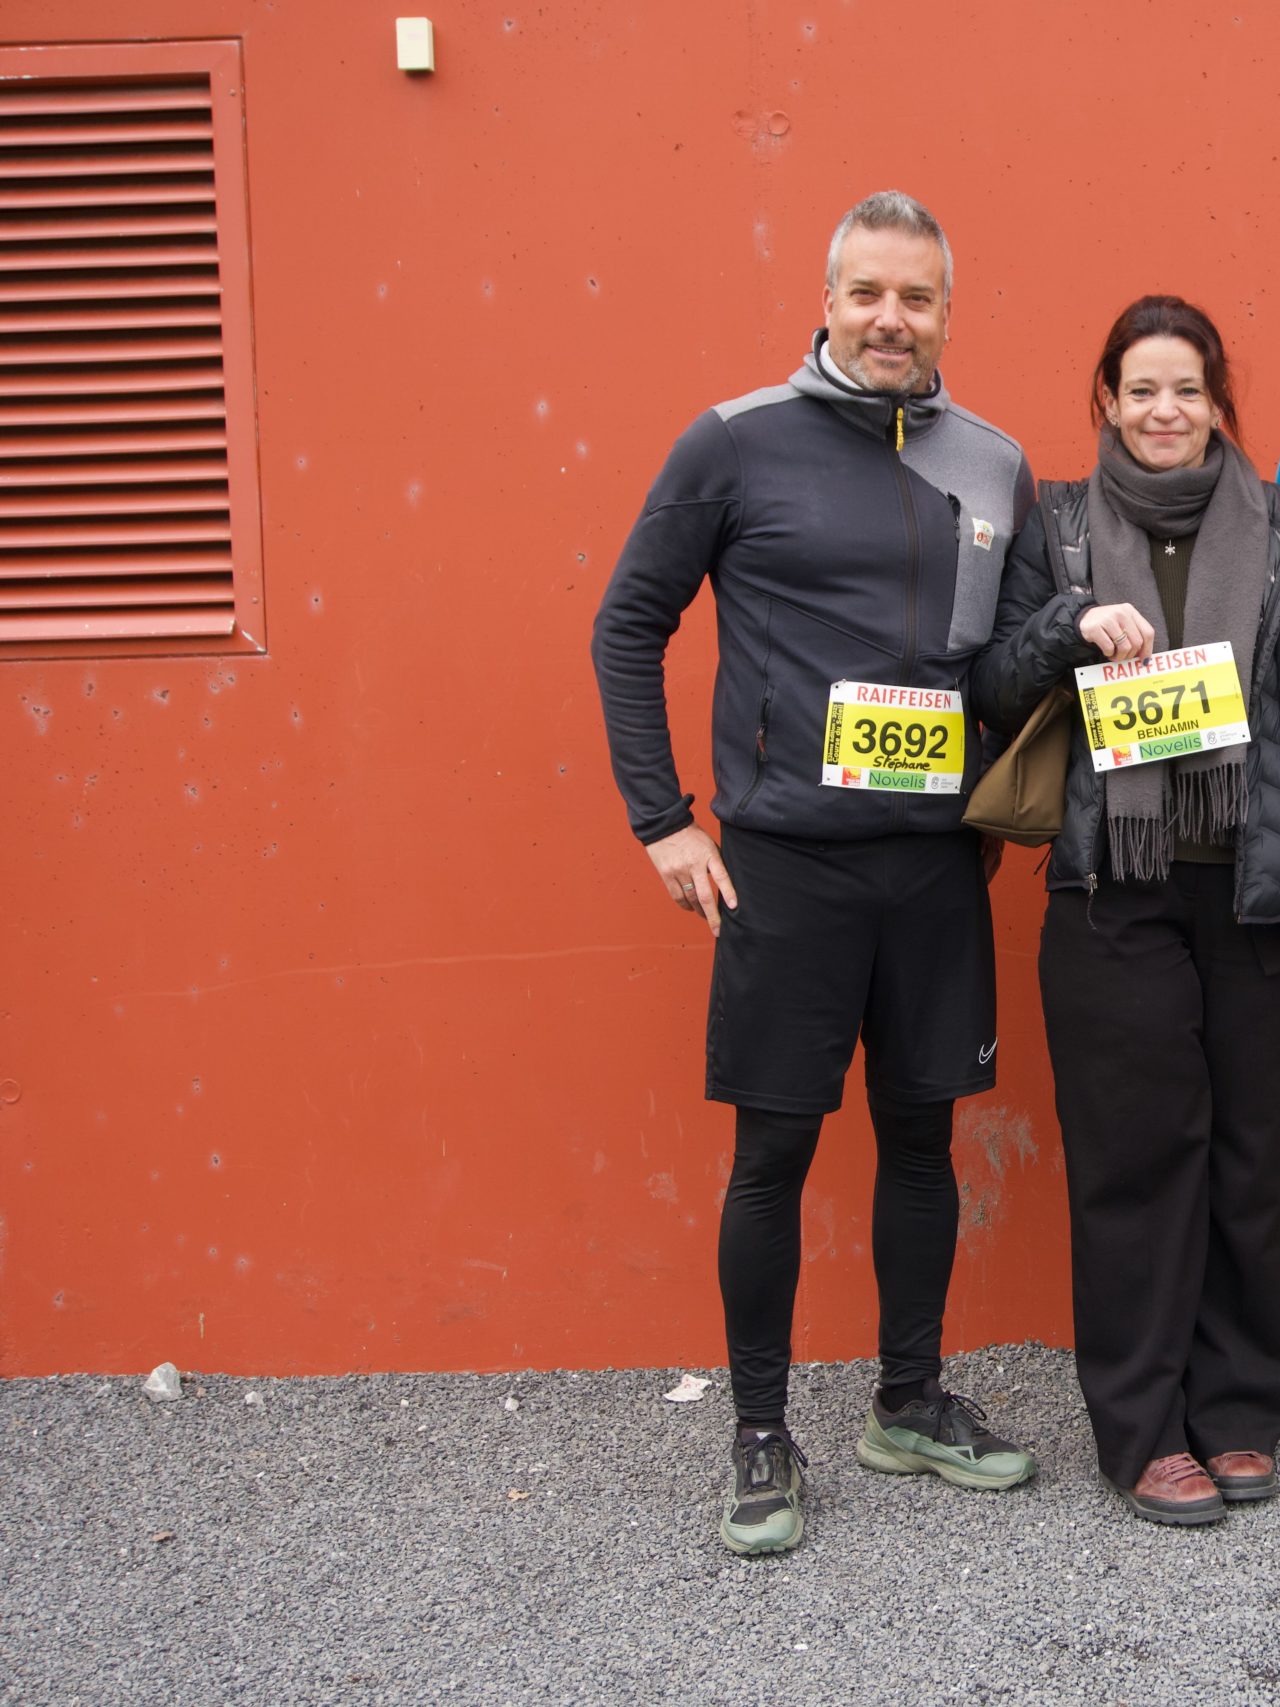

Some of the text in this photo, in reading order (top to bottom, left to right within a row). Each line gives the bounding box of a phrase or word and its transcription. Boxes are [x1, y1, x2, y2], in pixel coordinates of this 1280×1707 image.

[1103, 648, 1207, 682] RAIFFEISEN
[857, 686, 951, 709] RAIFFEISEN
[1088, 689, 1097, 710] Soleil
[1110, 680, 1211, 731] 3671
[852, 718, 949, 760] 3692
[1096, 722, 1105, 747] Course
[1137, 719, 1200, 740] BENJAMIN
[832, 737, 840, 763] Course
[836, 726, 842, 737] du
[1139, 735, 1202, 759] Novelis
[869, 772, 926, 789] Novelis
